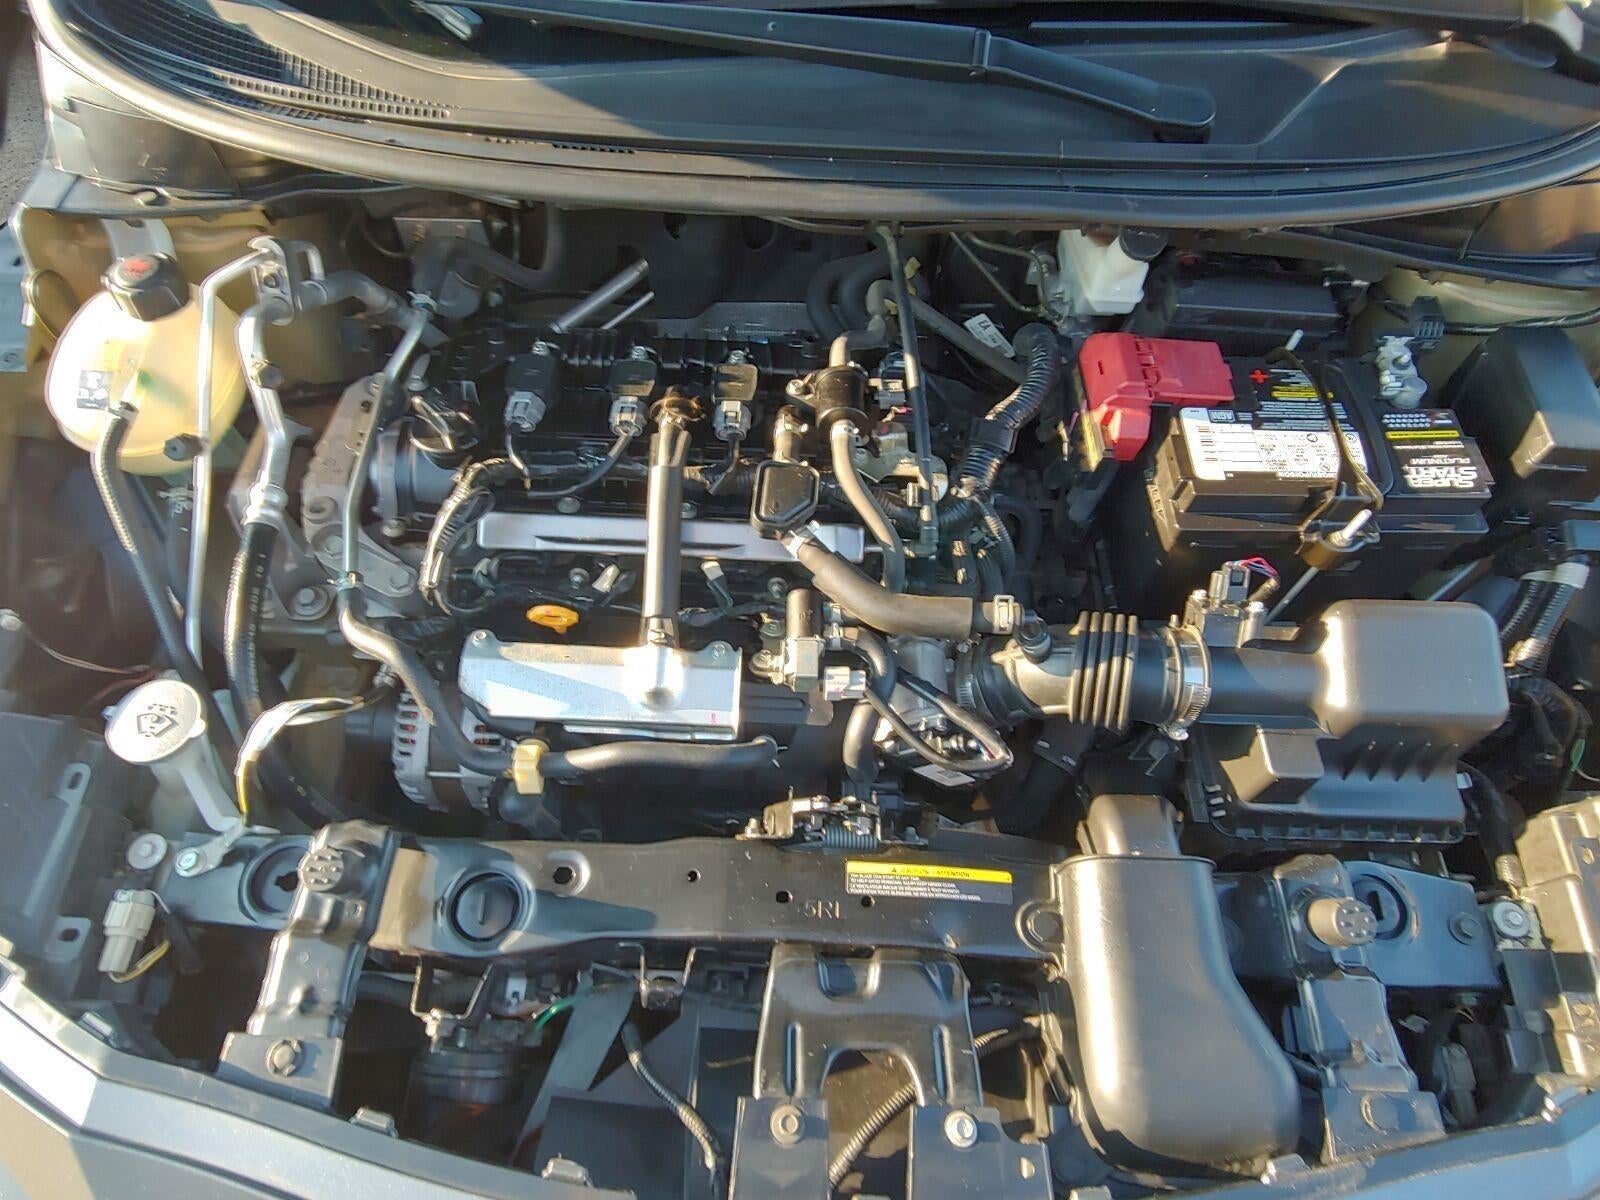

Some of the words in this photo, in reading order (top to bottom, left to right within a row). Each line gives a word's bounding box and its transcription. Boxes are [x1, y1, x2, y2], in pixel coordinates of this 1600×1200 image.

[1409, 457, 1471, 465] PLATINUM
[1403, 466, 1477, 479] START
[1408, 478, 1474, 487] SUPER
